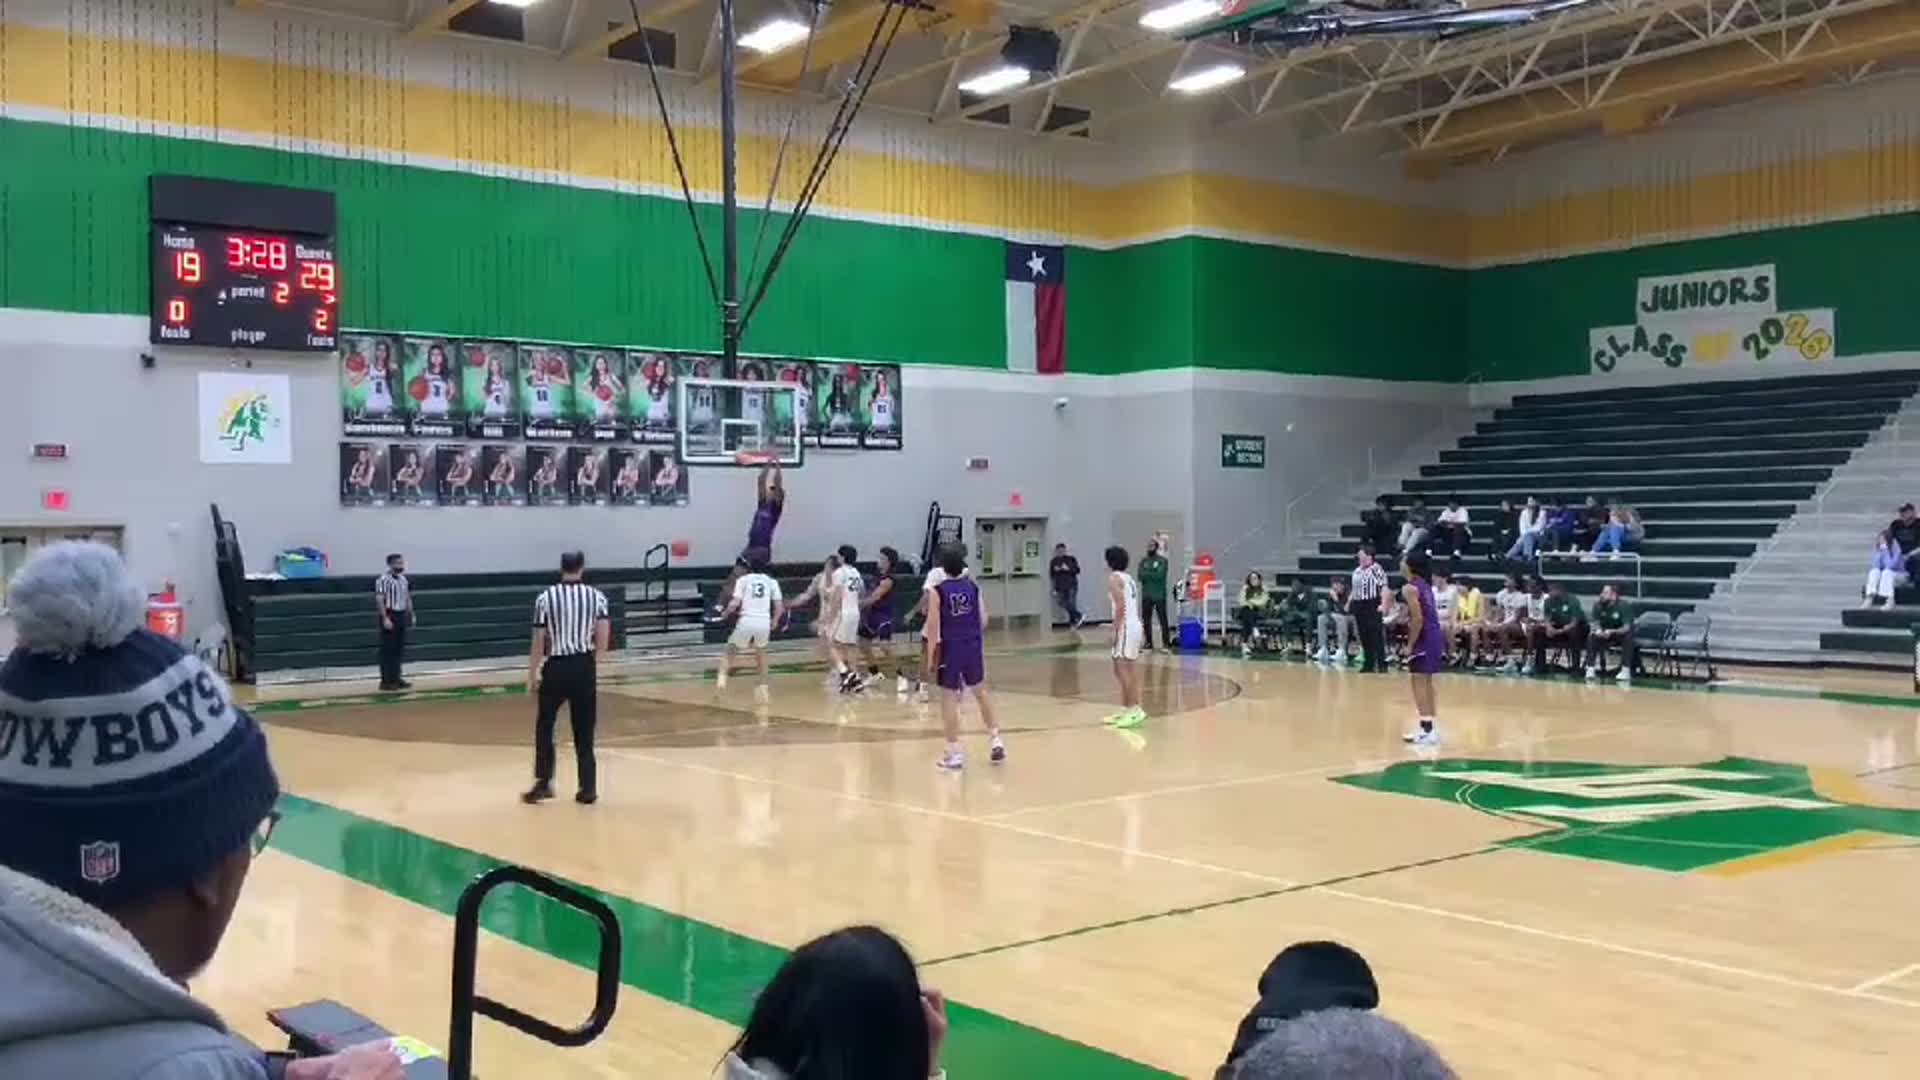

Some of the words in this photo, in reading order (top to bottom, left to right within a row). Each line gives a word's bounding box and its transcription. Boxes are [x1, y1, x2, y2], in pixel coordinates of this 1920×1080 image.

[163, 233, 195, 249] Home
[227, 238, 287, 271] 3:28
[176, 252, 200, 281] 19
[301, 262, 335, 290] 29
[231, 286, 265, 299] period
[275, 282, 289, 303] 2
[1640, 275, 1770, 313] JUNIORS
[169, 301, 185, 321] 0
[315, 310, 328, 330] 2
[1594, 325, 1688, 372] CLASS
[1742, 313, 1832, 361] 2026
[949, 593, 969, 616] 12
